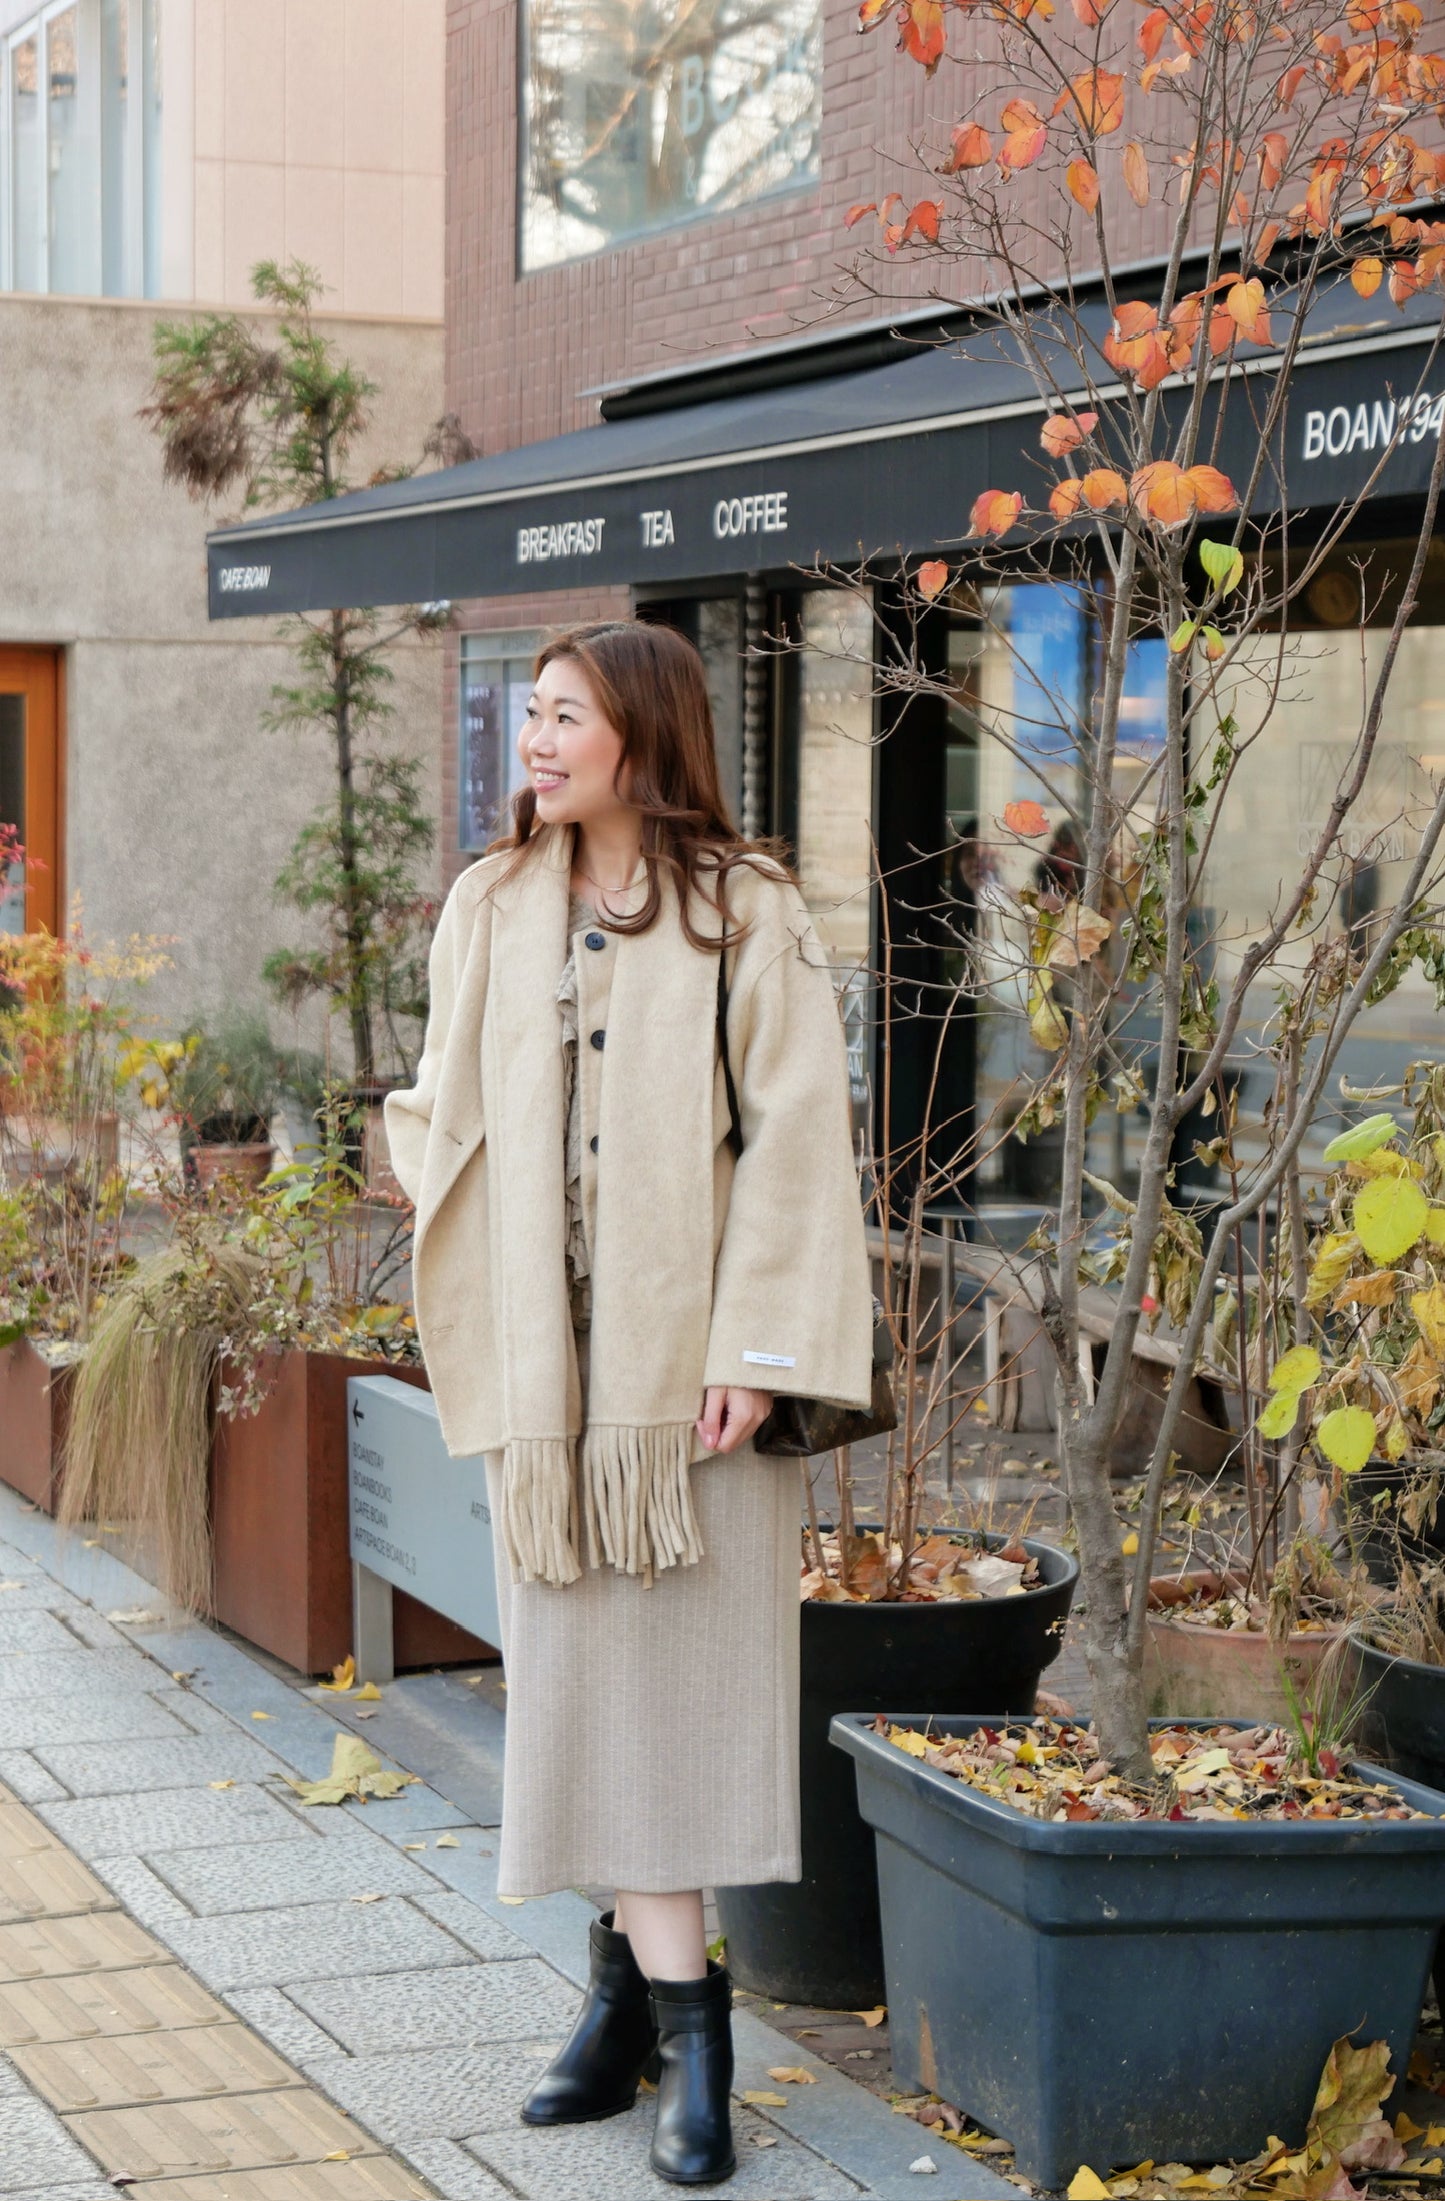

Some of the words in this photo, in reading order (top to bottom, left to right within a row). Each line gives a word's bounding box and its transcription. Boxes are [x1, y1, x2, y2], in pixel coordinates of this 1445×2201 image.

[518, 518, 605, 564] BREAKFAST
[640, 509, 675, 547] TEA
[713, 491, 788, 539] COFFEE
